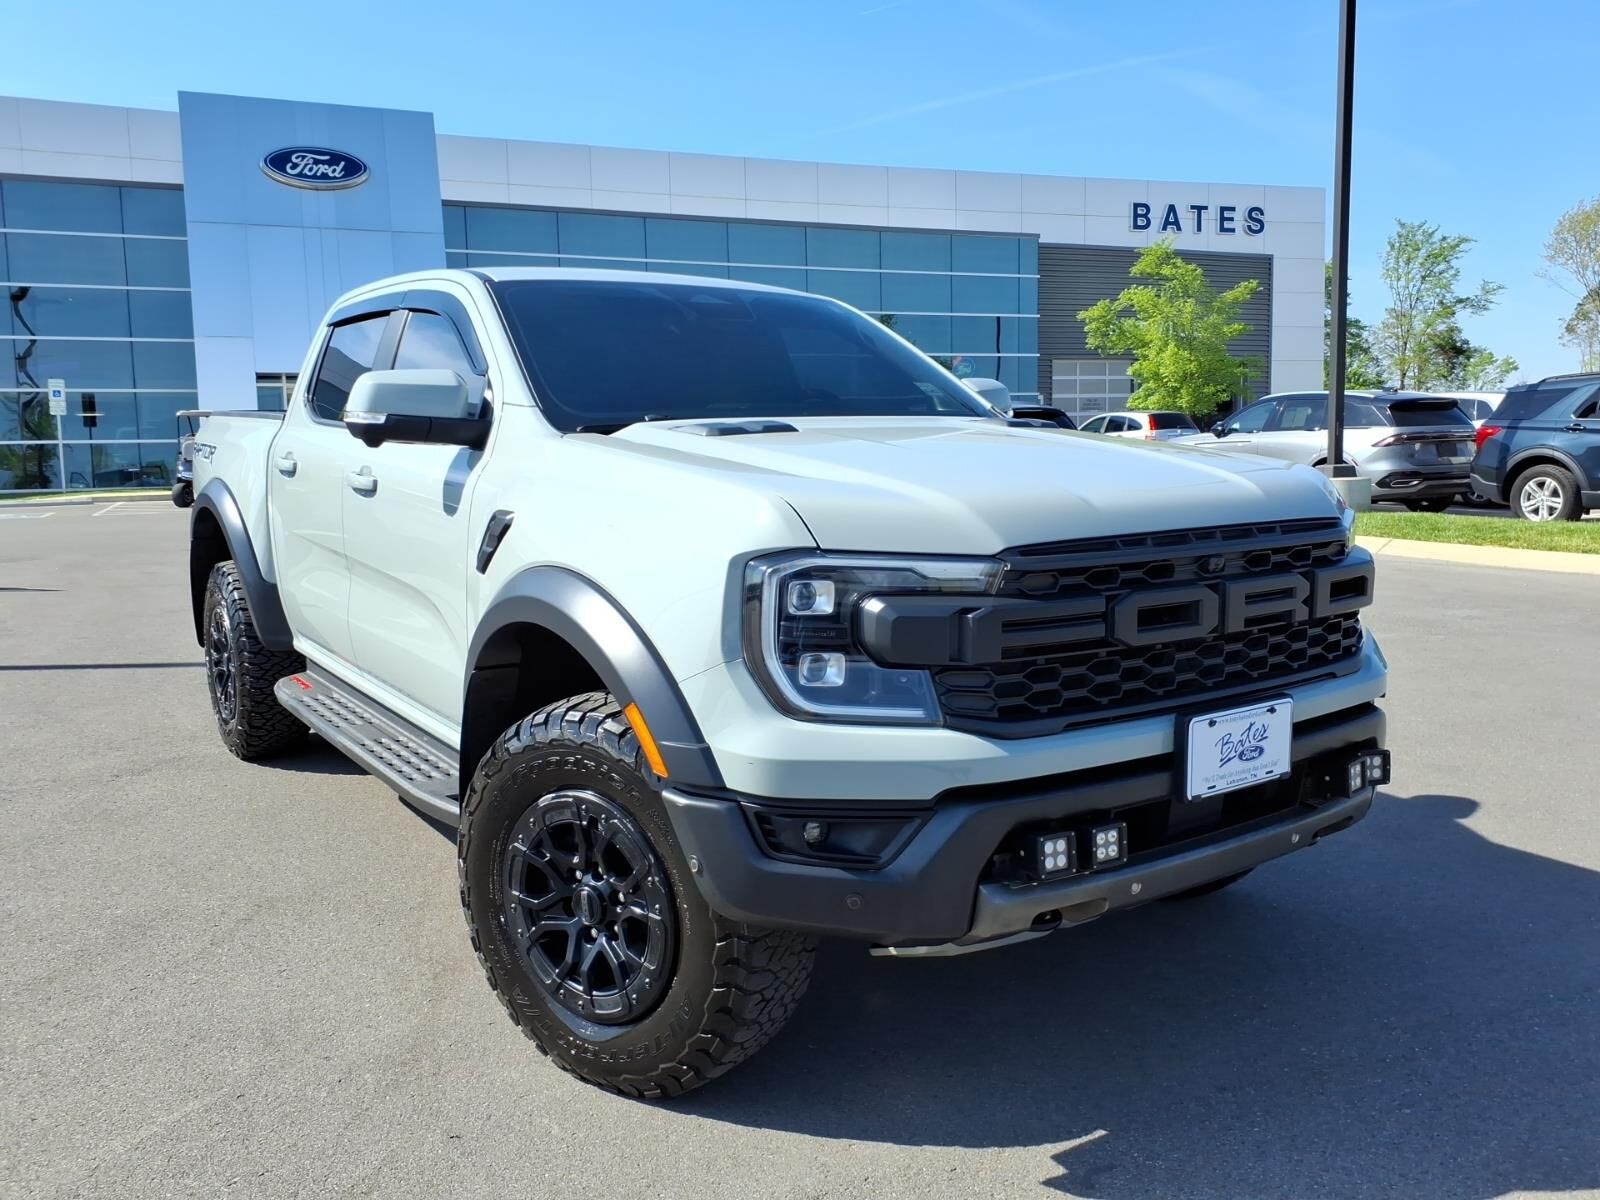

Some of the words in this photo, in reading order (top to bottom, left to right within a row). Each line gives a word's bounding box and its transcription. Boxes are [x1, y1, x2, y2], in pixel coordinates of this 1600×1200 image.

[286, 152, 345, 178] Ford
[1130, 202, 1265, 235] BATES
[966, 552, 1376, 664] FORD
[1215, 721, 1269, 766] Bates
